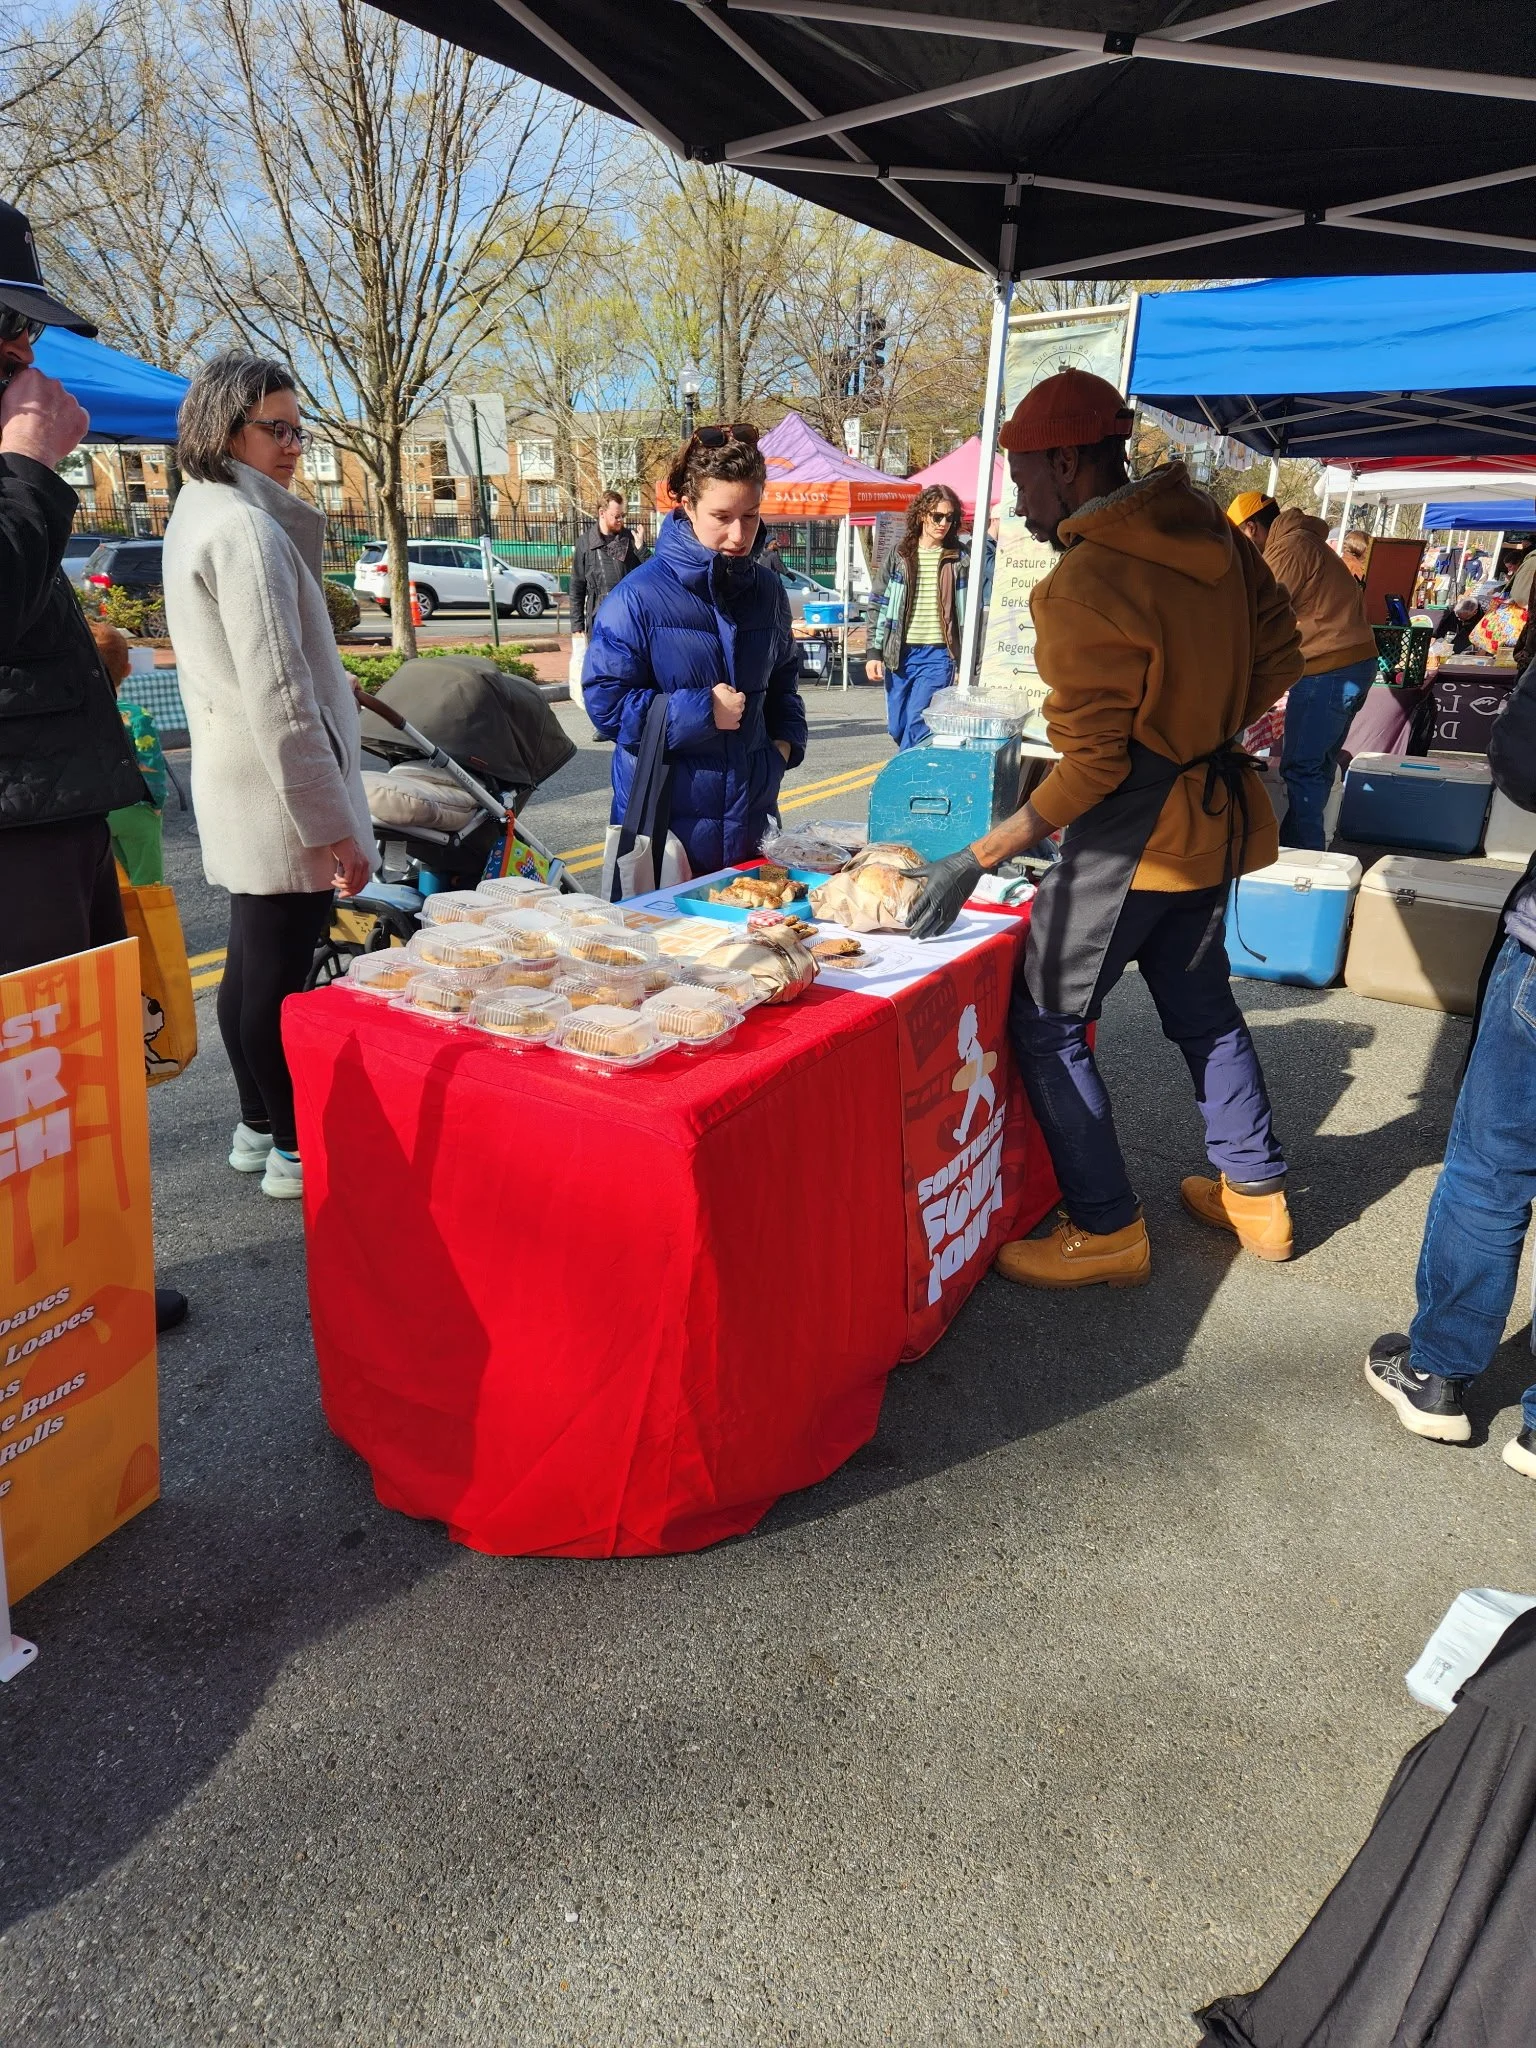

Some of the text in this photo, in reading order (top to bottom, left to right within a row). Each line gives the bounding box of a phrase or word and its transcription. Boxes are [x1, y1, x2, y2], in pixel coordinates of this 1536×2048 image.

[775, 491, 829, 502] SALMON
[1006, 558, 1046, 569] Pasture
[4, 1305, 95, 1367] Loaves
[20, 1372, 86, 1423] Buns
